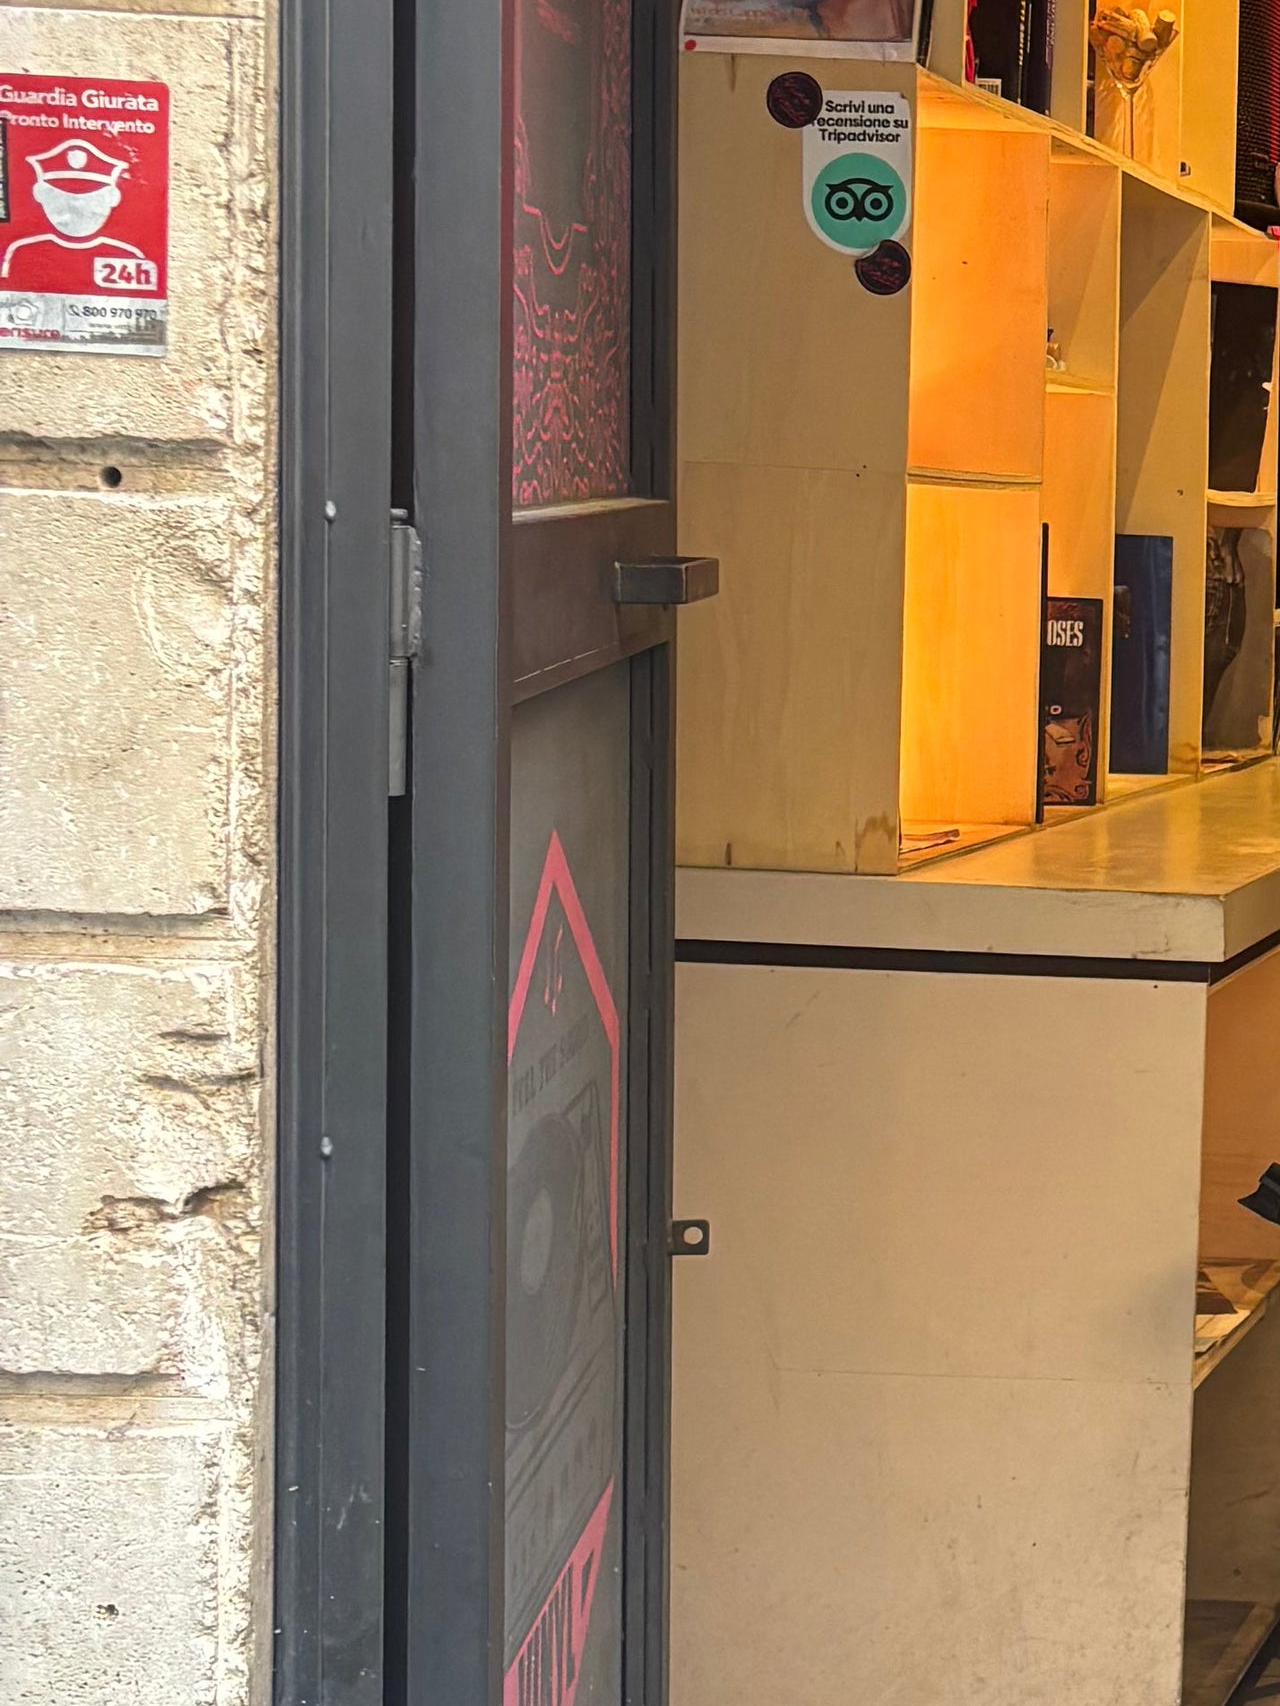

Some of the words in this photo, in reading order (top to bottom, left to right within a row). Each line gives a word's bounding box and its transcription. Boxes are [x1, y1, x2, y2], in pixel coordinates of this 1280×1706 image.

[0, 84, 78, 107] Guardia
[81, 89, 160, 112] Giurata
[825, 100, 865, 114] Scrivi
[868, 104, 895, 114] una
[0, 110, 60, 129] Pronto
[62, 113, 156, 135] Intervento
[893, 119, 909, 129] su
[819, 129, 901, 144] Tripadvisor
[101, 263, 152, 285] 24h
[82, 305, 107, 318] 800
[110, 307, 132, 319] 970
[0, 326, 61, 341] erisure
[1047, 619, 1084, 647] OSES
